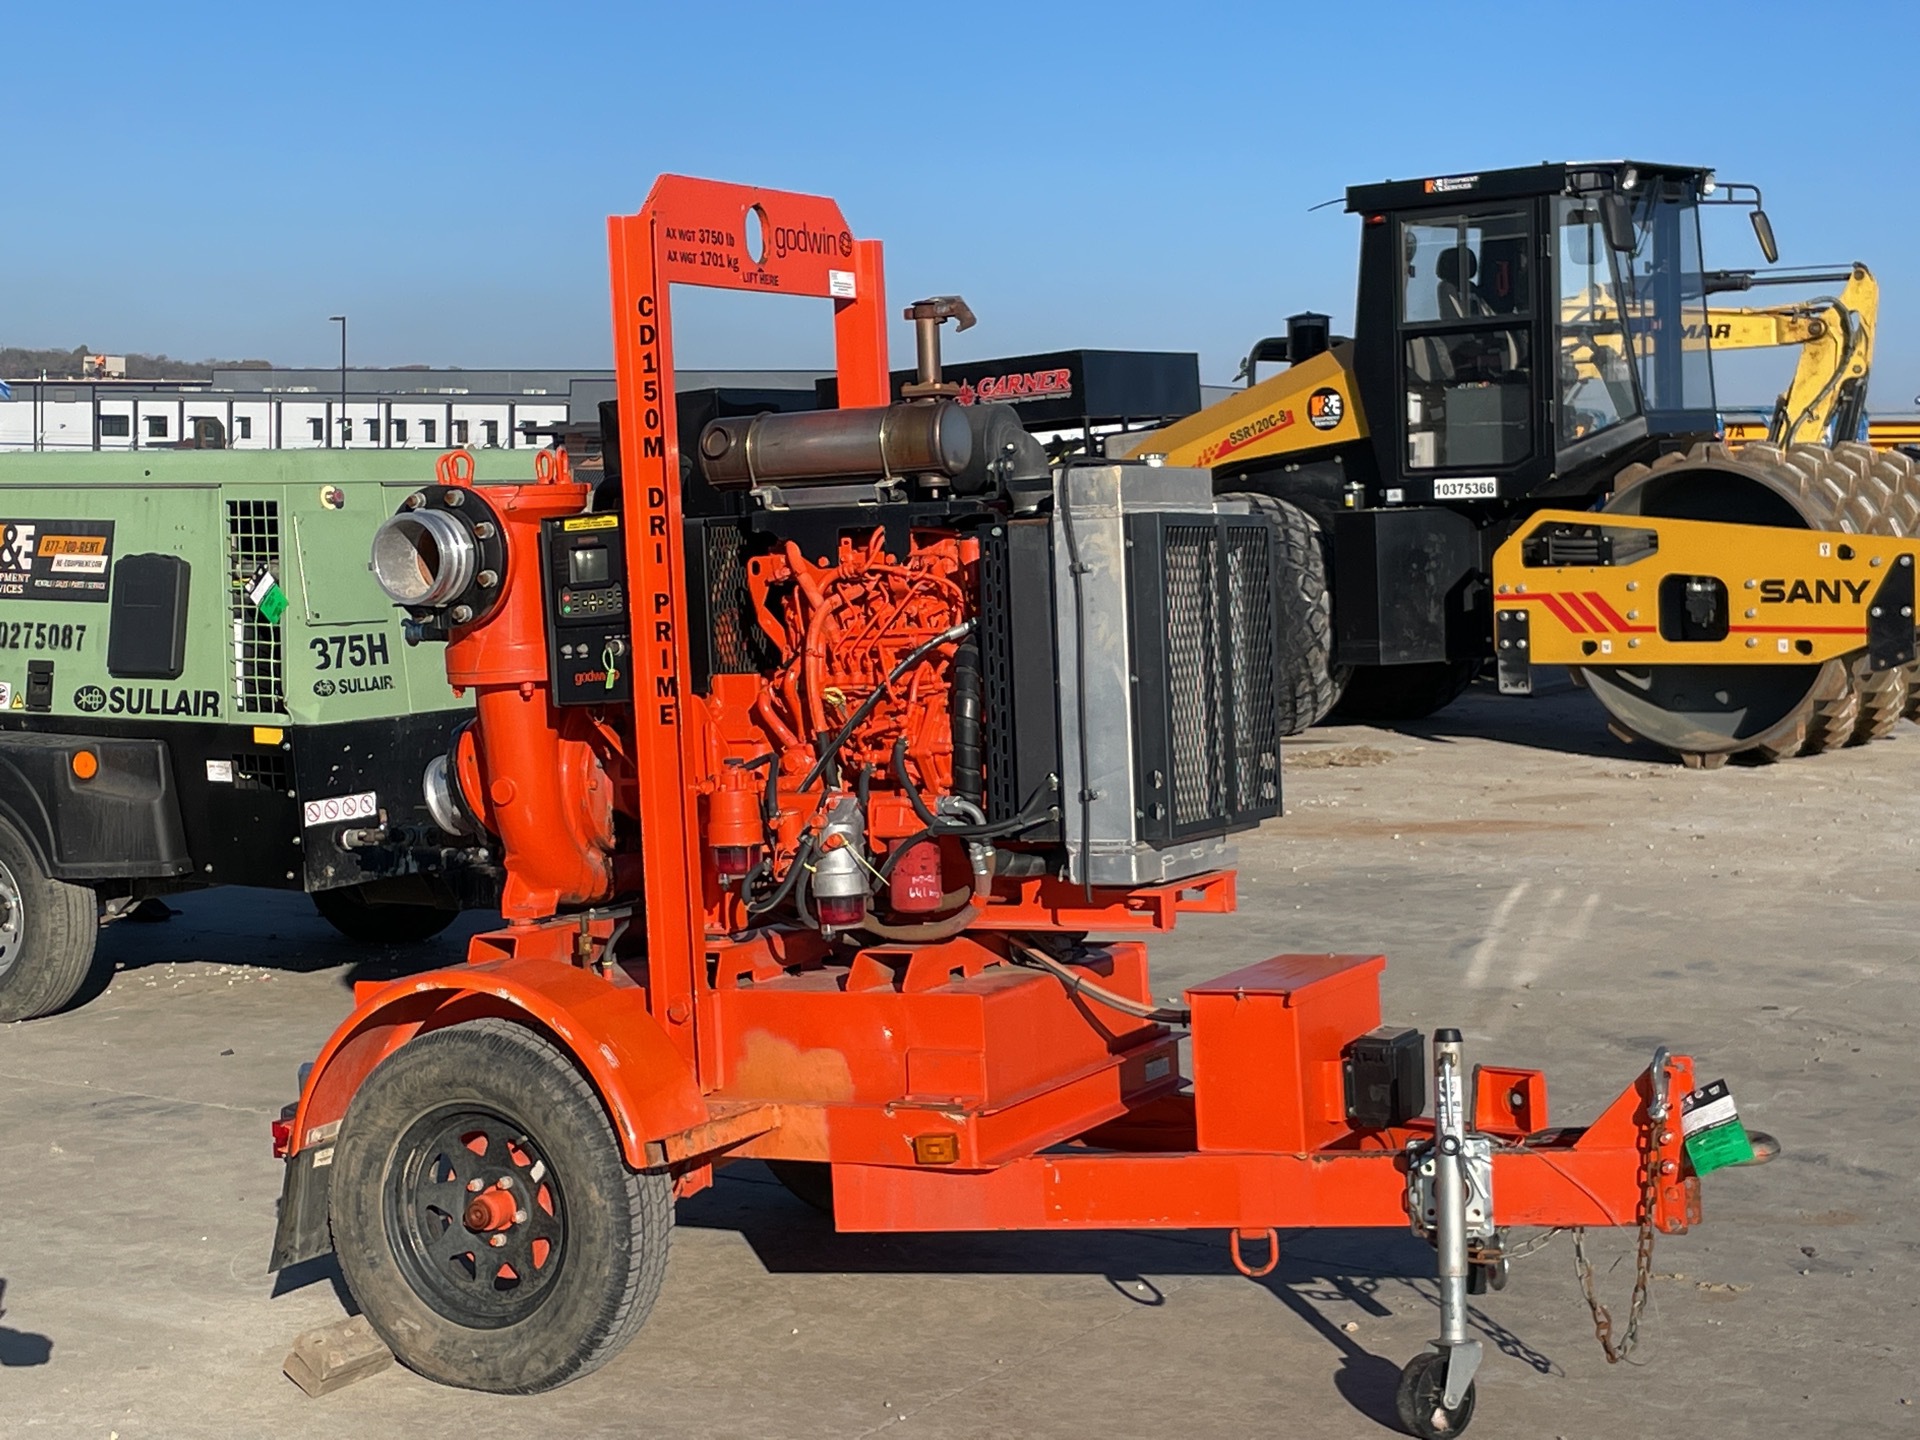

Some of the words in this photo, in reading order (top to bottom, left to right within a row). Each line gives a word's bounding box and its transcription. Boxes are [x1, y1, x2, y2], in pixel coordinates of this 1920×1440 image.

[666, 227, 676, 240] AX
[678, 229, 696, 242] WGT
[698, 229, 724, 246] 3750
[725, 233, 735, 247] lb
[775, 221, 837, 259] godwin
[667, 250, 678, 262] AX
[680, 252, 697, 264] WGT
[700, 250, 725, 268] 1701
[727, 254, 740, 272] kg
[742, 272, 758, 283] LIFT
[759, 272, 779, 286] HERE
[638, 296, 665, 458] CD150M
[977, 368, 1071, 398] GARNER
[1311, 394, 1341, 416] H&E
[1229, 409, 1288, 445] SSR120C-8
[1435, 482, 1495, 496] 10375366
[648, 487, 667, 564] DRI
[1760, 579, 1872, 604] SANY
[0, 621, 87, 652] 0275087
[309, 632, 390, 671] 375H
[654, 593, 678, 726] PRIME
[338, 675, 396, 695] SULLAIR
[108, 686, 220, 718] SULLAIR
